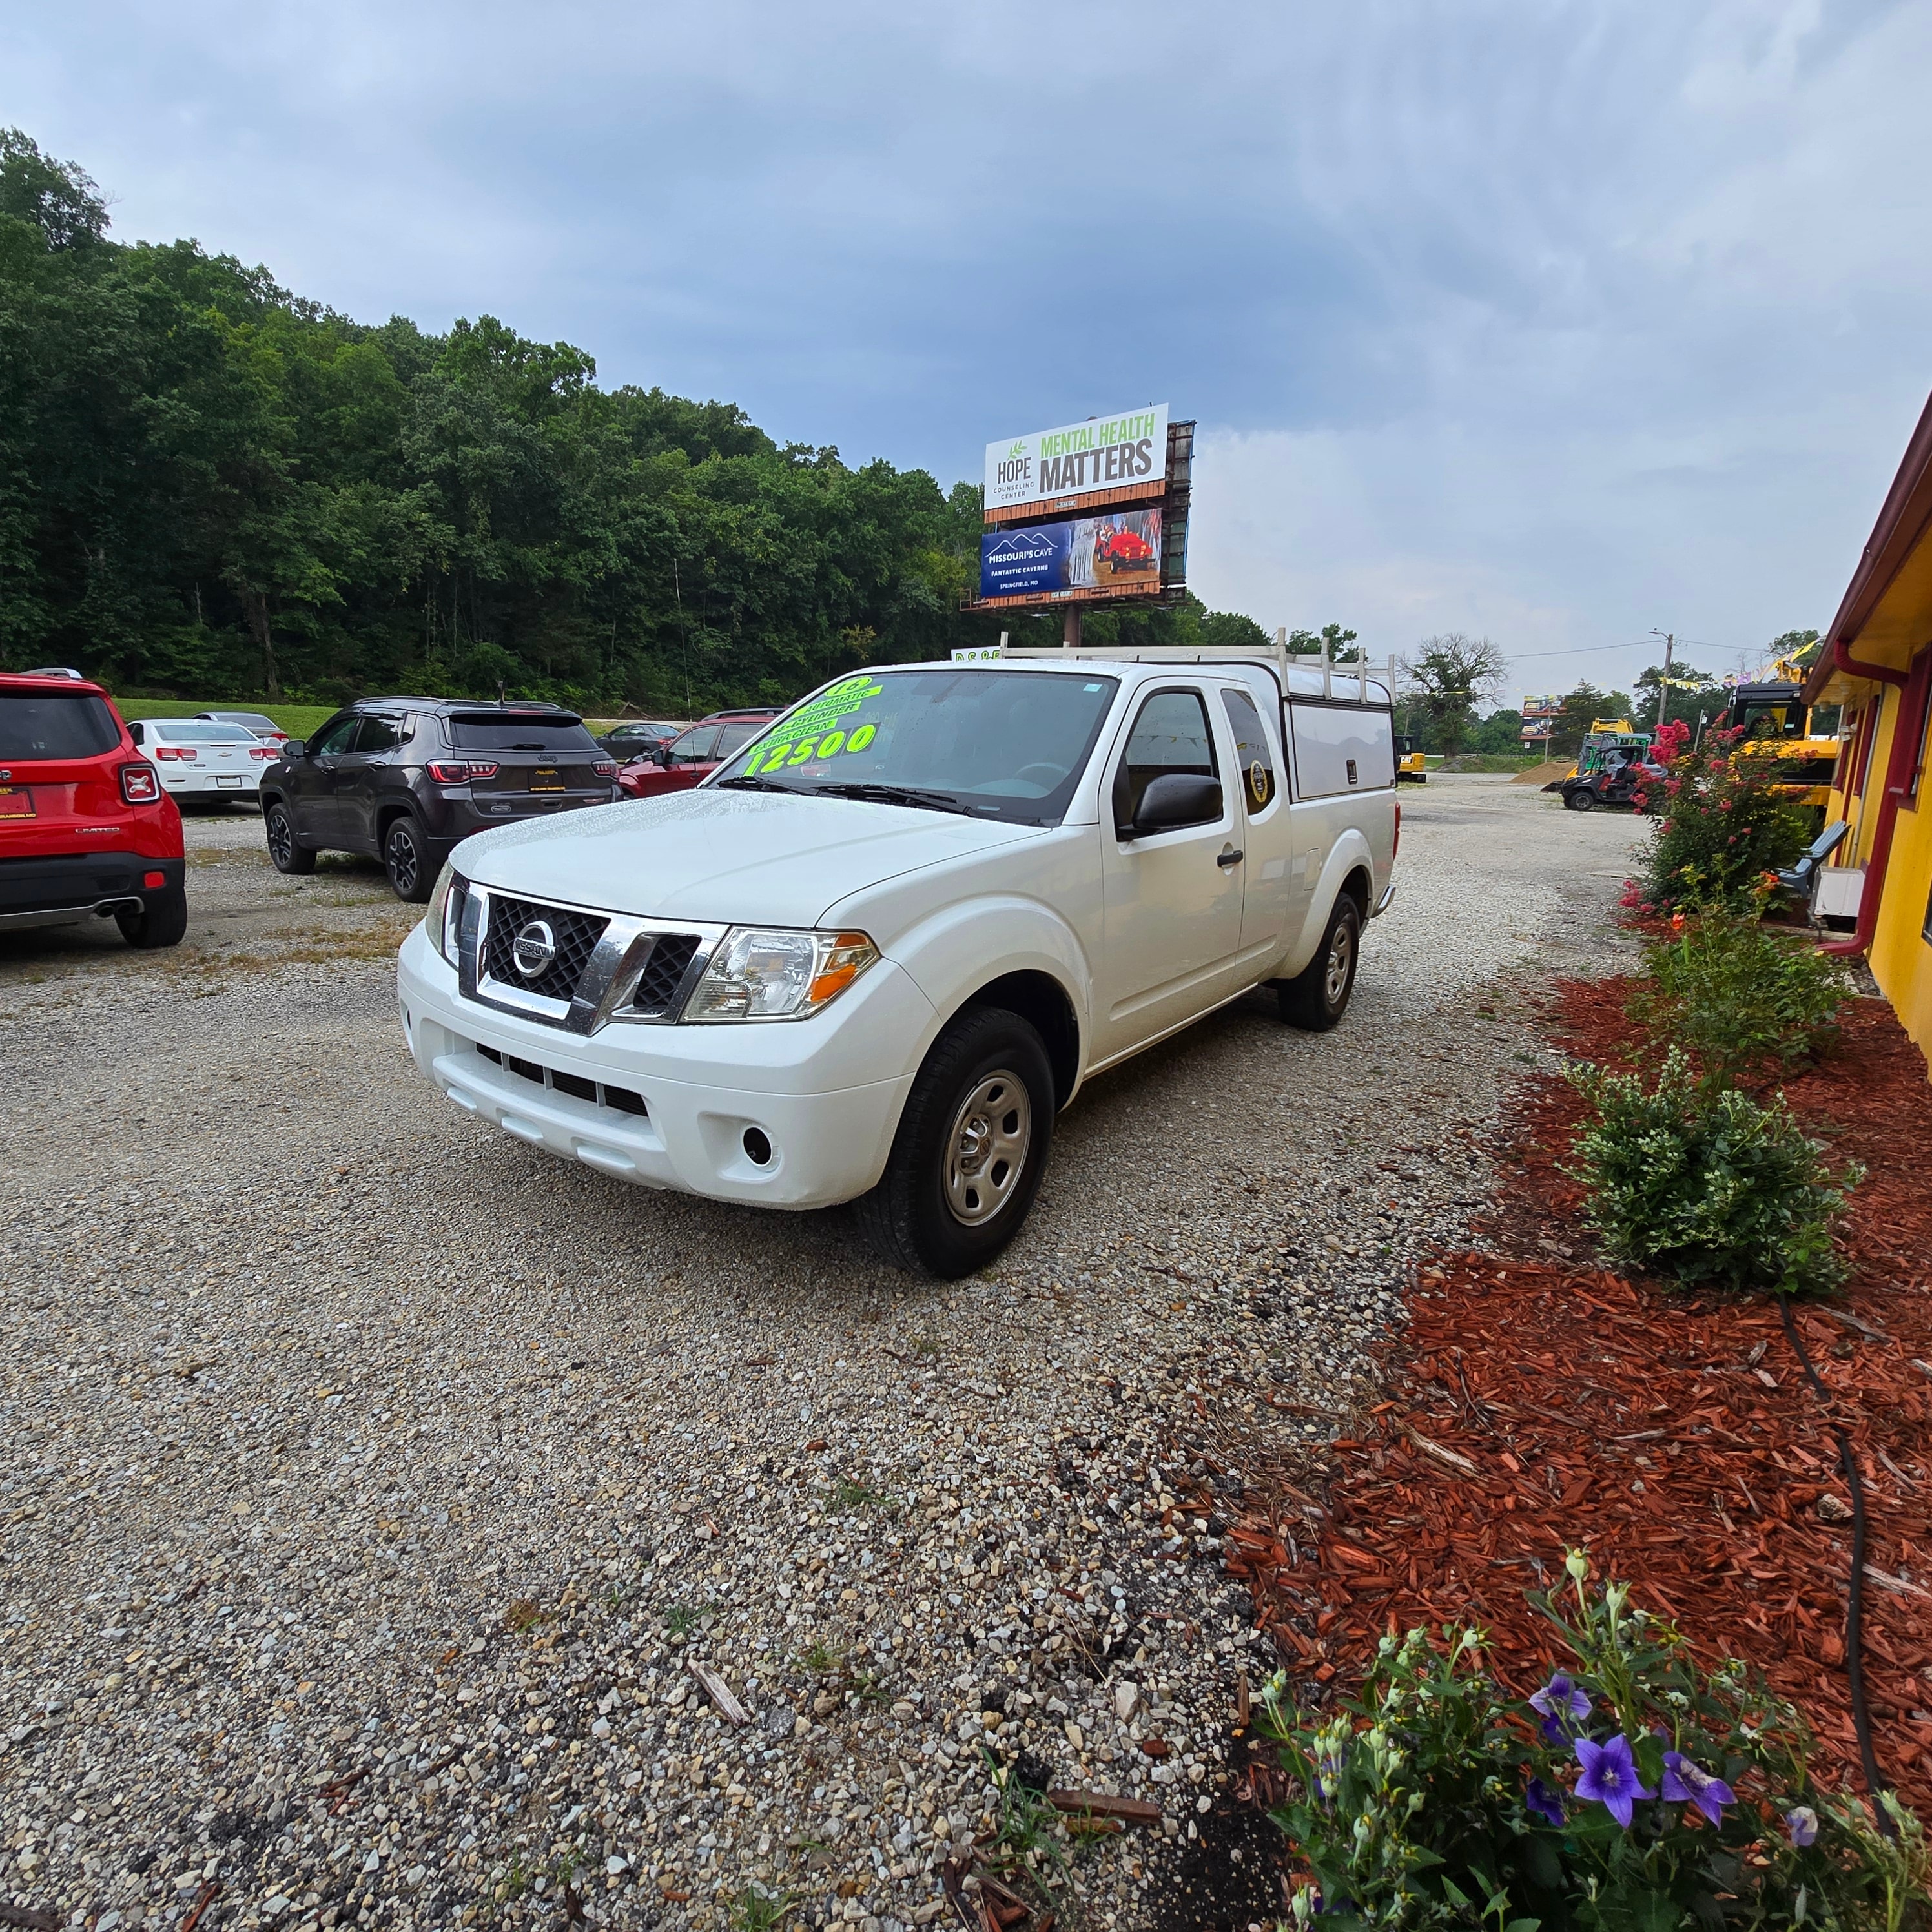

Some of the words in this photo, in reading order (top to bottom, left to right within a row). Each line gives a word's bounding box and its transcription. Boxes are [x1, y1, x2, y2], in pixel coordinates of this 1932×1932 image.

[1040, 427, 1096, 459] MENTAL
[1099, 413, 1155, 447] HEALTH
[998, 457, 1032, 484] HOPE
[1040, 438, 1153, 494] MATTERS
[993, 481, 1034, 494] COUNSELING
[1001, 491, 1026, 500] CENTER
[989, 550, 1033, 564] MISSOURI'S
[1034, 547, 1053, 557] CAVE
[991, 568, 1022, 577] FANTASTIC
[1022, 564, 1049, 573] CAVERNS
[1000, 581, 1030, 590] SPRINGFIELD,
[833, 679, 860, 695] 16
[804, 689, 870, 714] AUTOMATIC
[775, 703, 858, 734] 4-CYLINDER
[754, 733, 790, 752] EXTRA
[792, 720, 830, 739] CLEAN
[537, 754, 558, 763] Jeep
[743, 724, 876, 777] 12500
